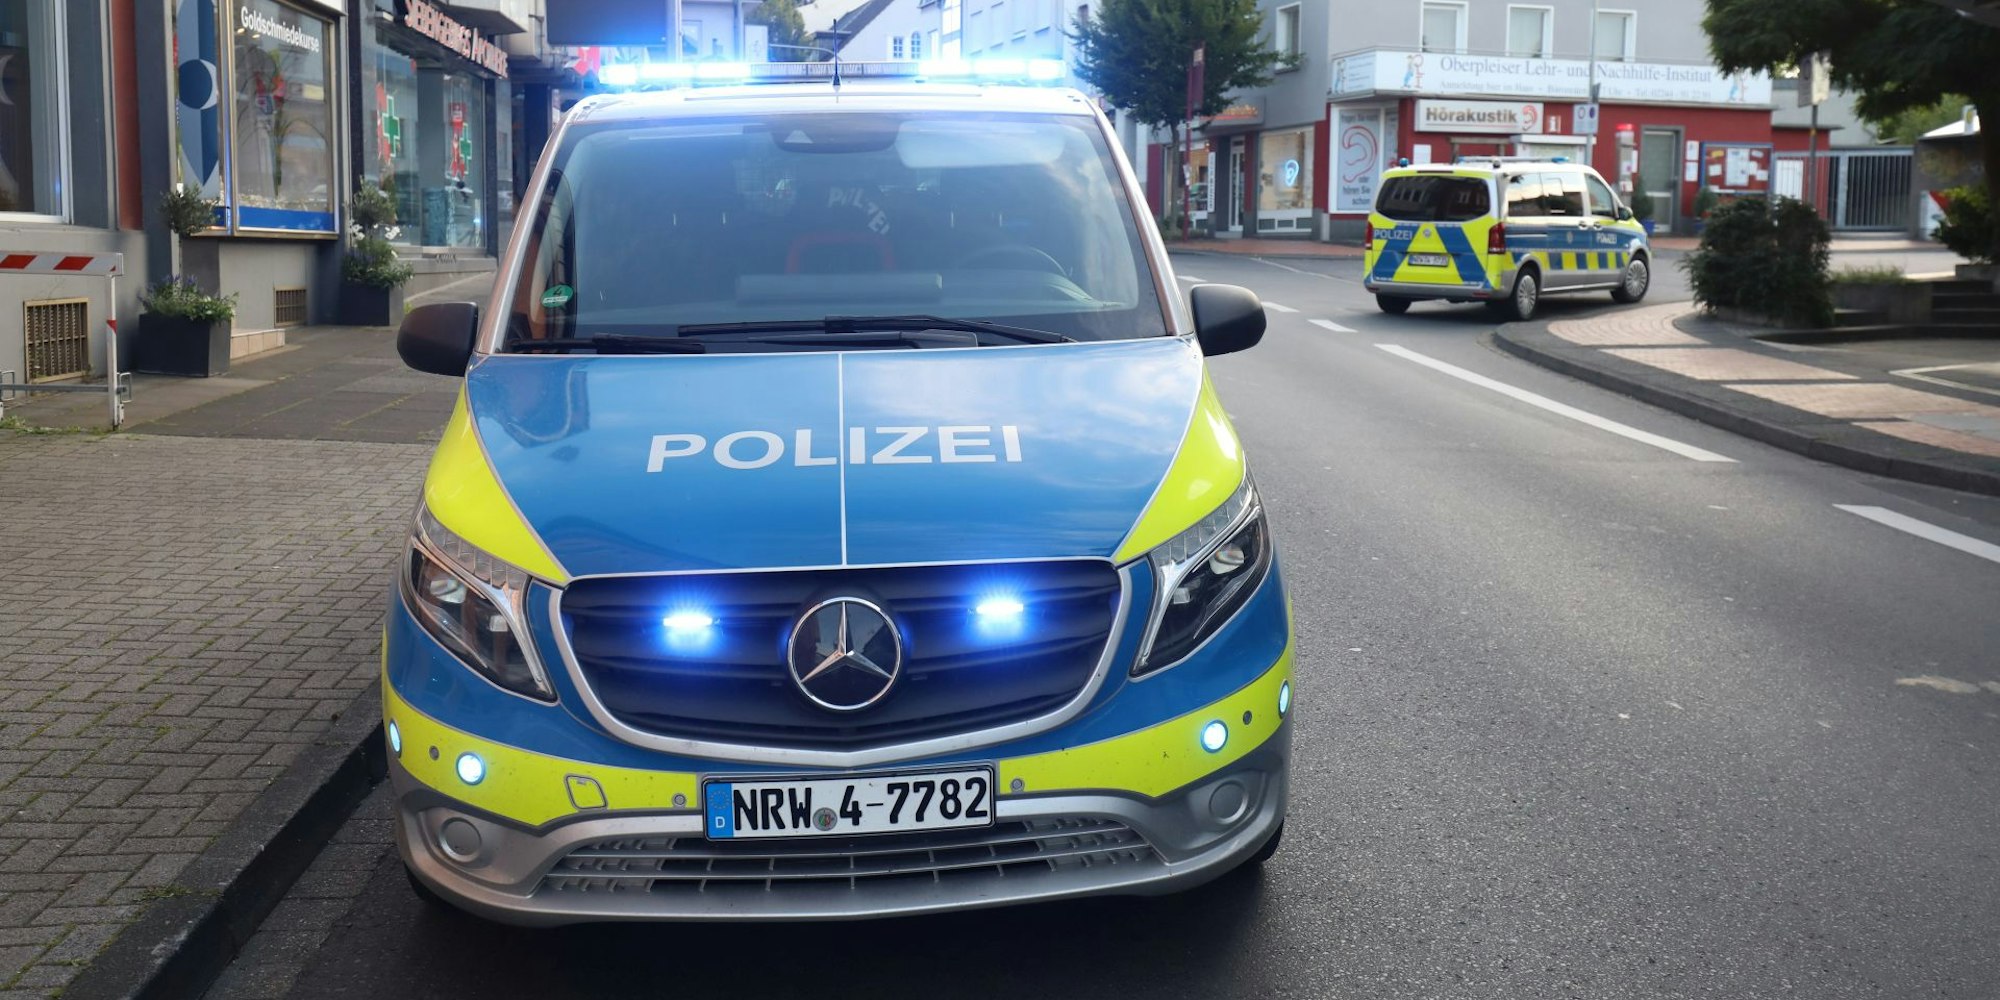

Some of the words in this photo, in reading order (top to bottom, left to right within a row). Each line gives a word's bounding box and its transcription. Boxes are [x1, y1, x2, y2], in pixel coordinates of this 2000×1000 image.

[241, 6, 320, 53] Goldschmiedekurse
[1440, 56, 1521, 76] Oberpleiser
[1525, 60, 1563, 76] Lehr-
[1597, 64, 1712, 83] Nachhilfe-Institut
[1426, 107, 1518, 123] Hörakustik
[1374, 229, 1413, 240] POLIZEI
[647, 425, 1022, 473] POLIZEI
[715, 816, 726, 828] D
[734, 787, 812, 830] NRW
[839, 777, 988, 825] 4-7782
